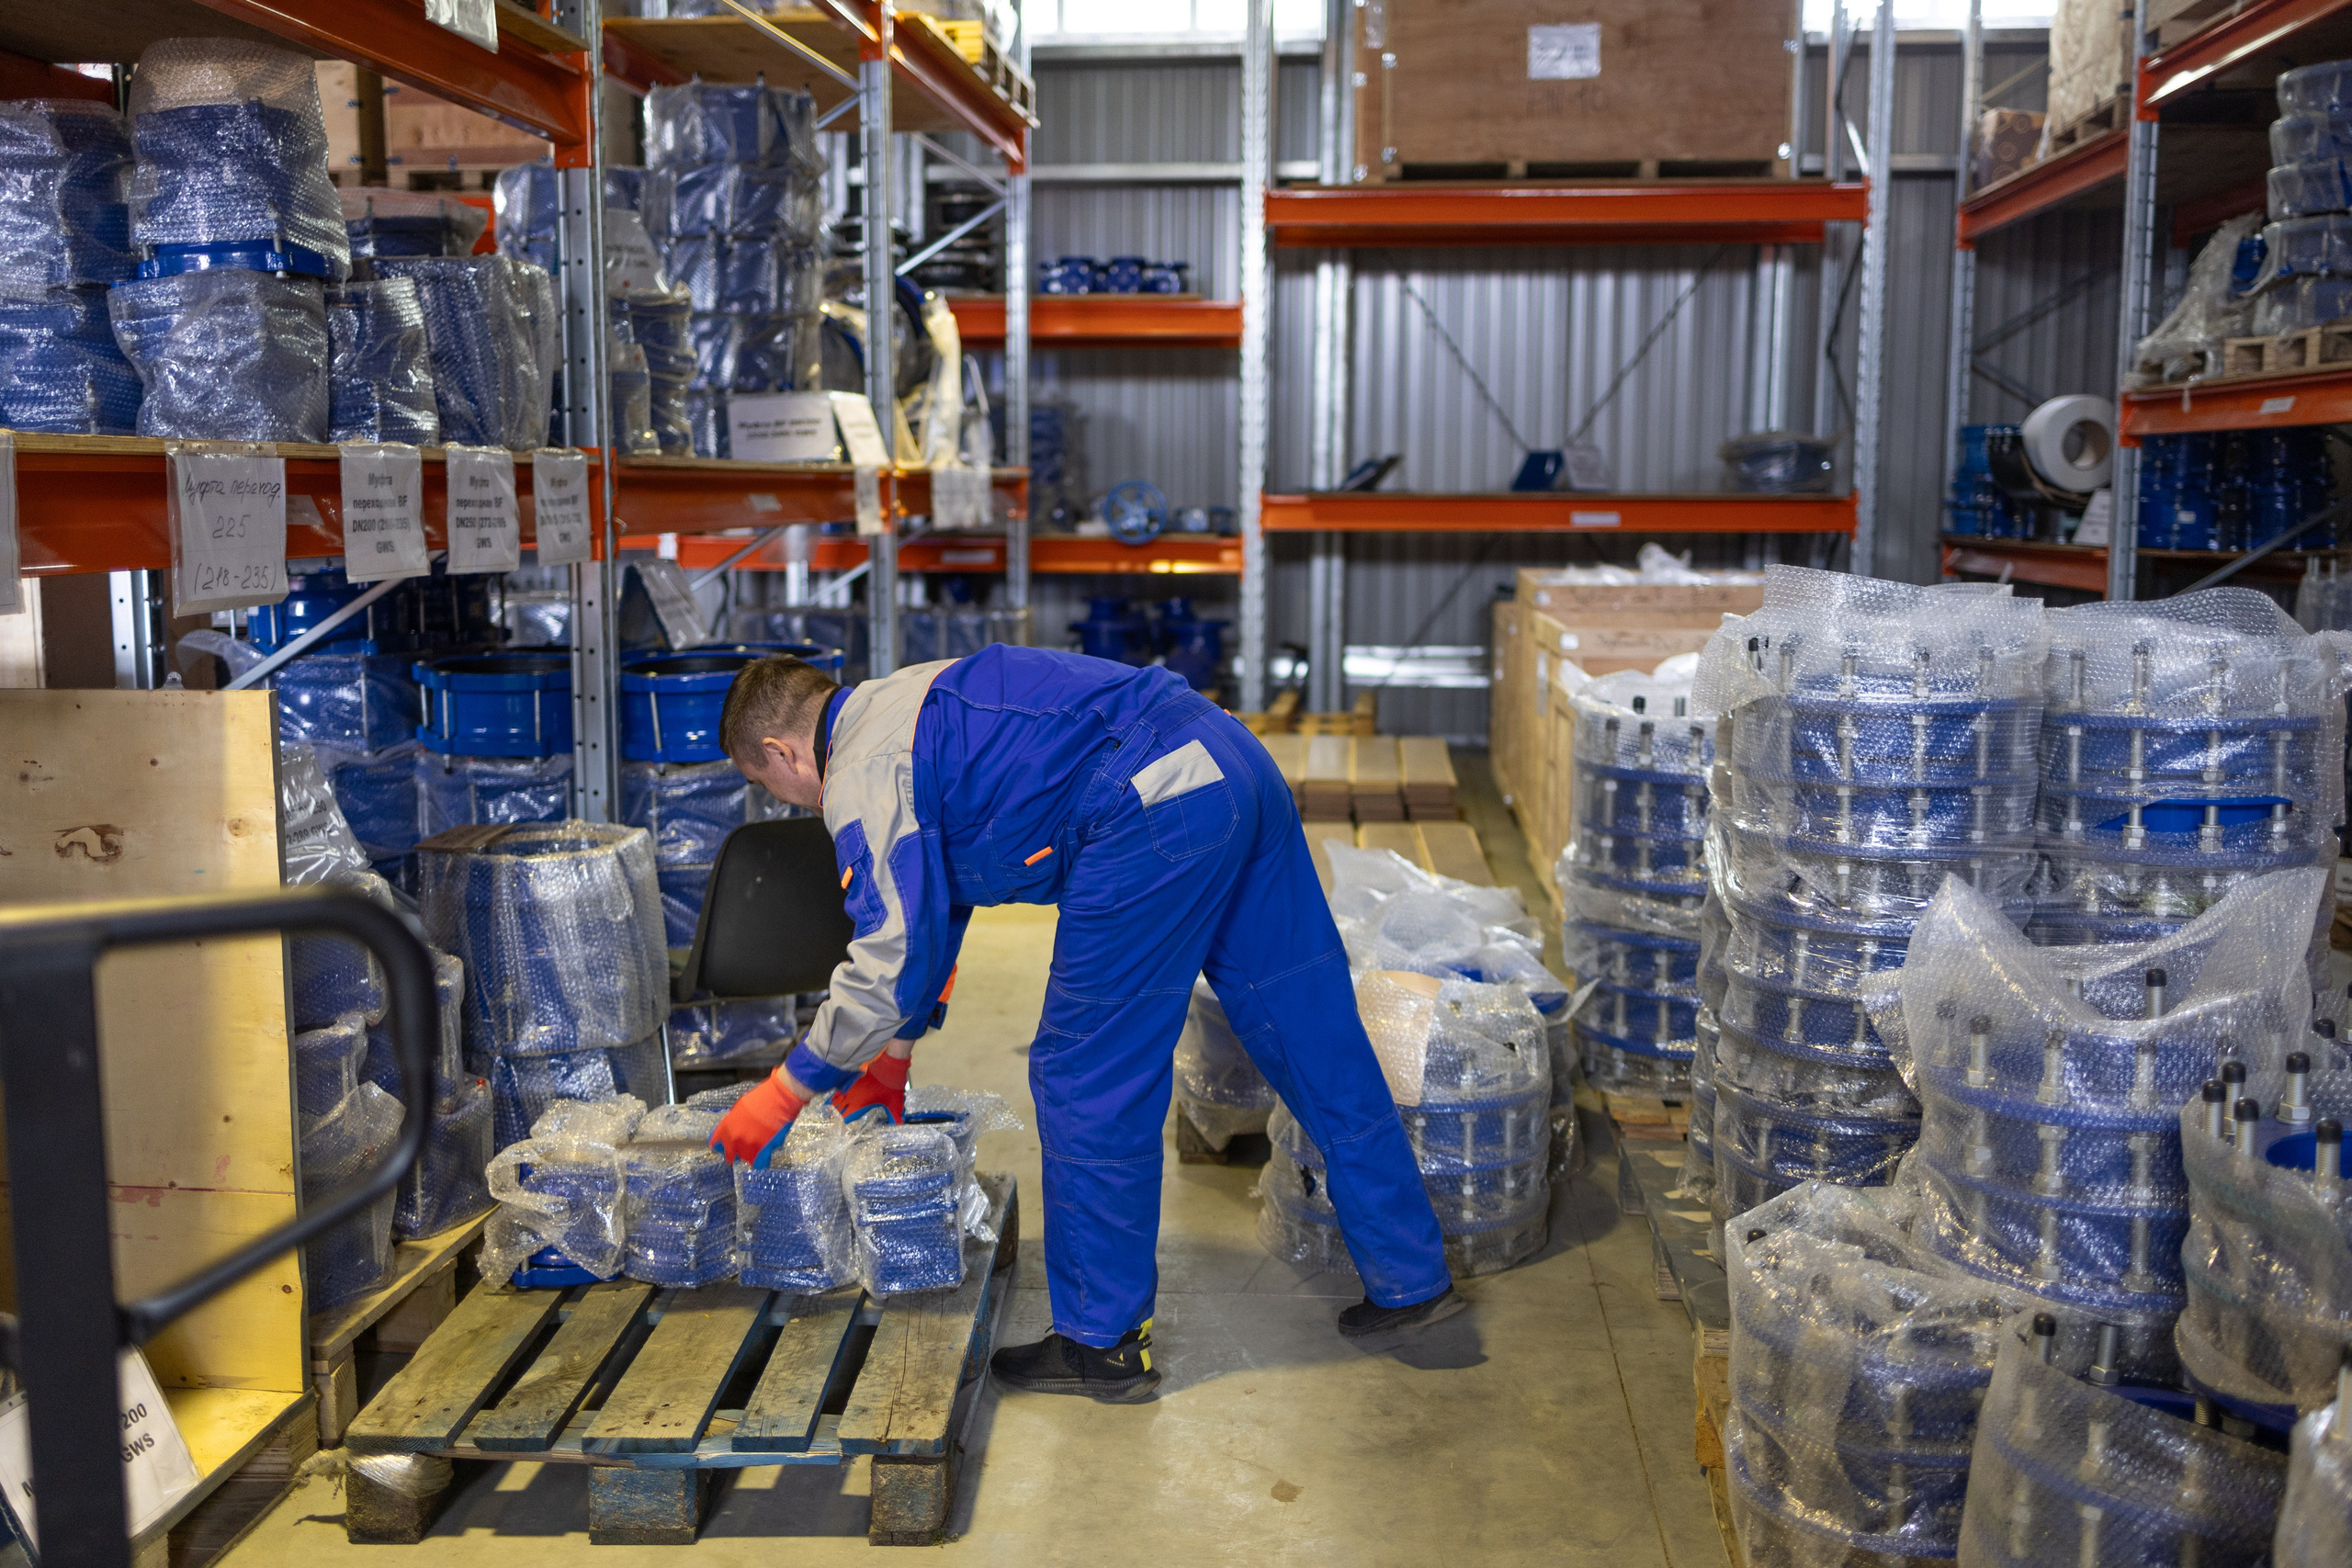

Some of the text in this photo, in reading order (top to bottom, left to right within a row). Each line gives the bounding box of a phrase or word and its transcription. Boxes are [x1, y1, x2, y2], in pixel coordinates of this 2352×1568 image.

[212, 513, 252, 539] 225
[376, 540, 395, 554] GWS
[121, 1432, 155, 1463] GWS
